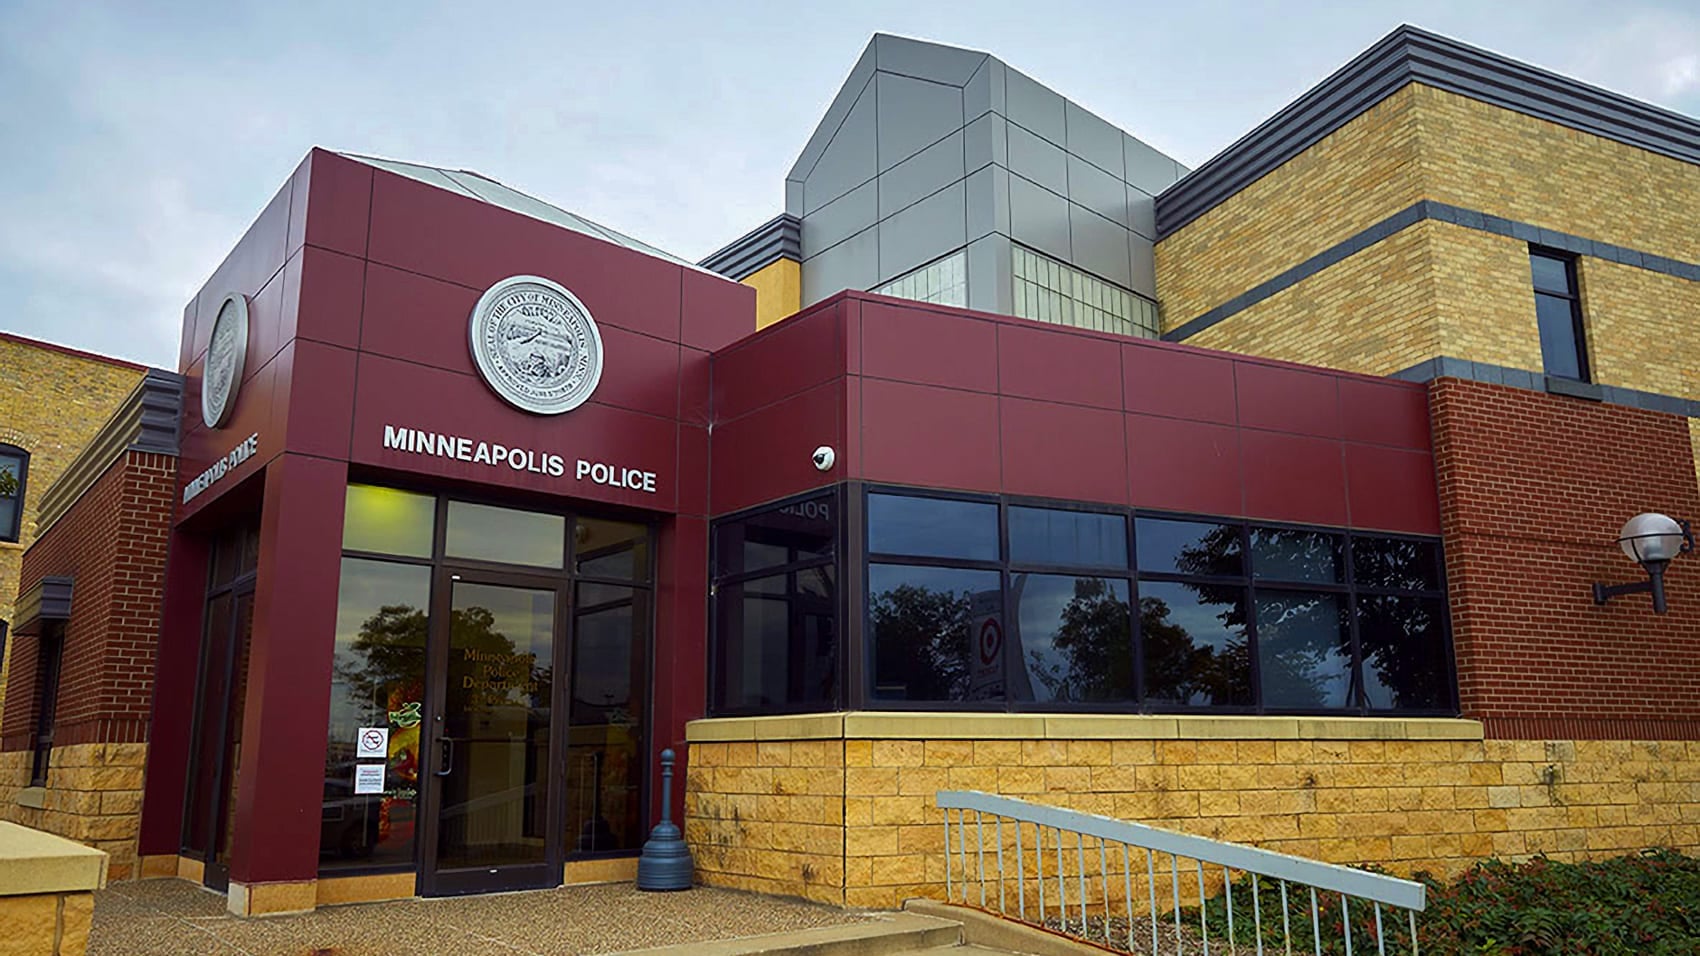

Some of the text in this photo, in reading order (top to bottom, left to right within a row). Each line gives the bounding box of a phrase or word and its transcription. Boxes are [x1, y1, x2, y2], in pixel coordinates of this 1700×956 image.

[488, 321, 498, 333] OF
[494, 304, 510, 320] THE
[507, 293, 528, 306] CITY
[528, 293, 539, 302] OF
[540, 295, 586, 349] MINNEAPOLIS
[383, 425, 656, 492] MINNEAPOLIS POLICE
[483, 665, 520, 678] Police
